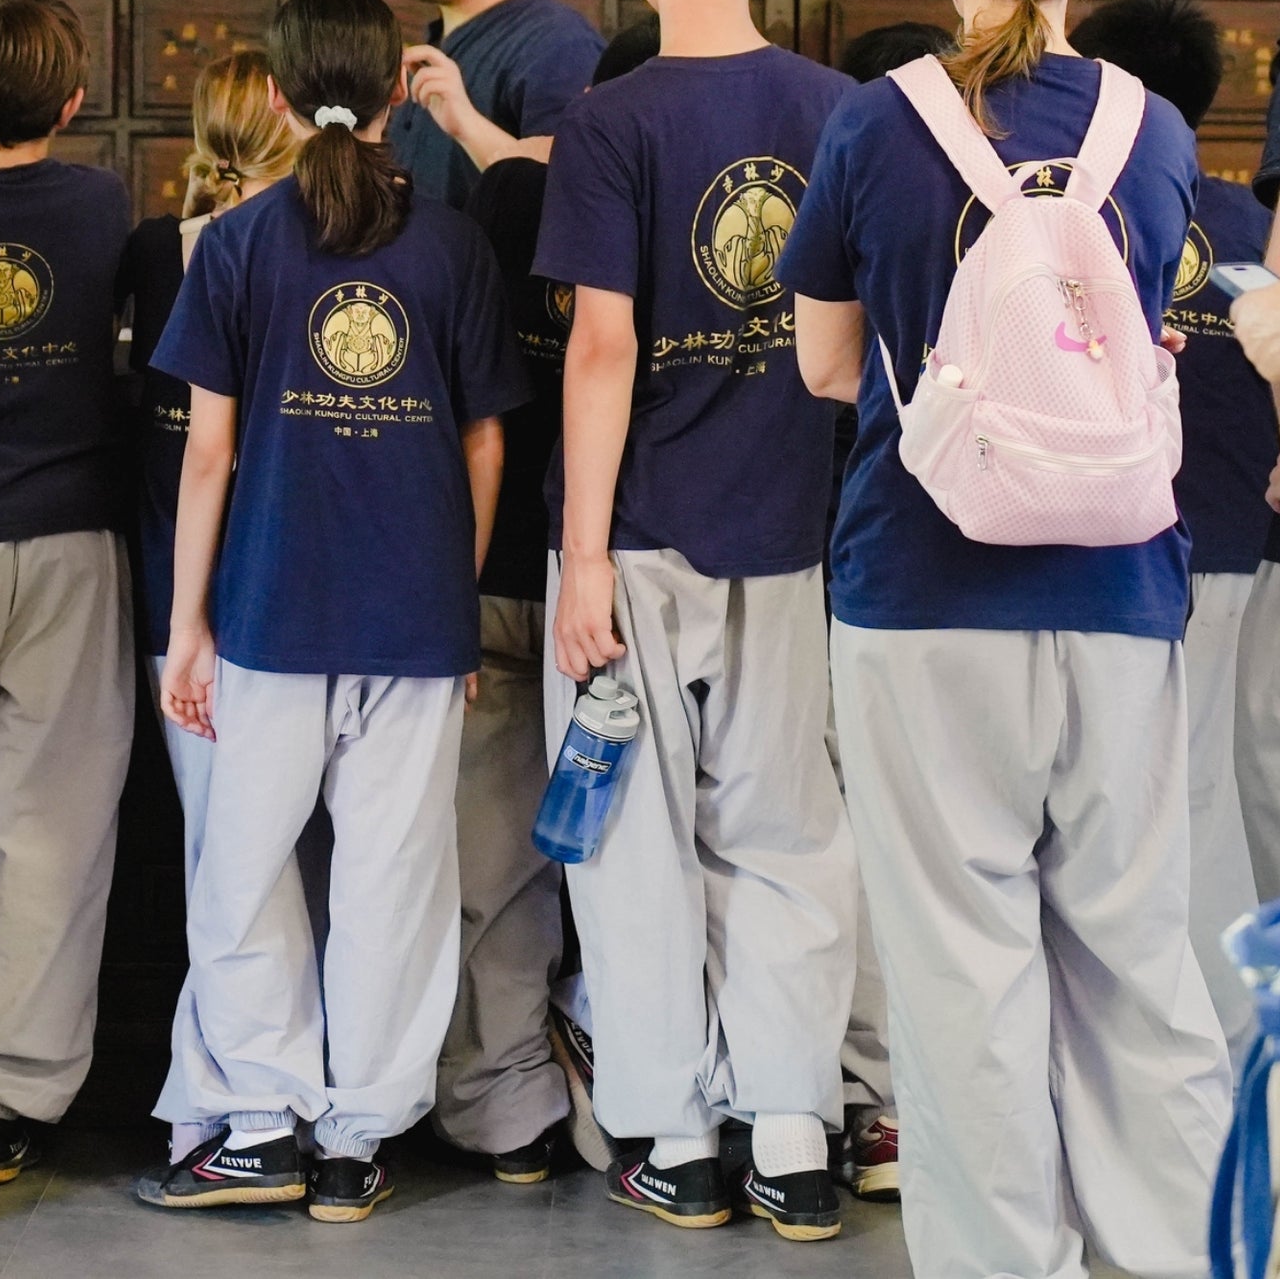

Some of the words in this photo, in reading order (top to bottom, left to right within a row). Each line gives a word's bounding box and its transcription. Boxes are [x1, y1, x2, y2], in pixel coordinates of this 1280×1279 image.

[700, 245, 727, 292] SHAOLIN
[738, 337, 795, 354] CULTURA
[327, 363, 356, 383] KUNGFU
[356, 365, 393, 383] CULTURAL
[281, 389, 433, 412] 少林功夫文化中心
[314, 409, 352, 420] KUNGFU
[355, 412, 401, 422] CULTURAL
[573, 755, 609, 771] nalgene
[220, 1156, 262, 1169] FEIYUE
